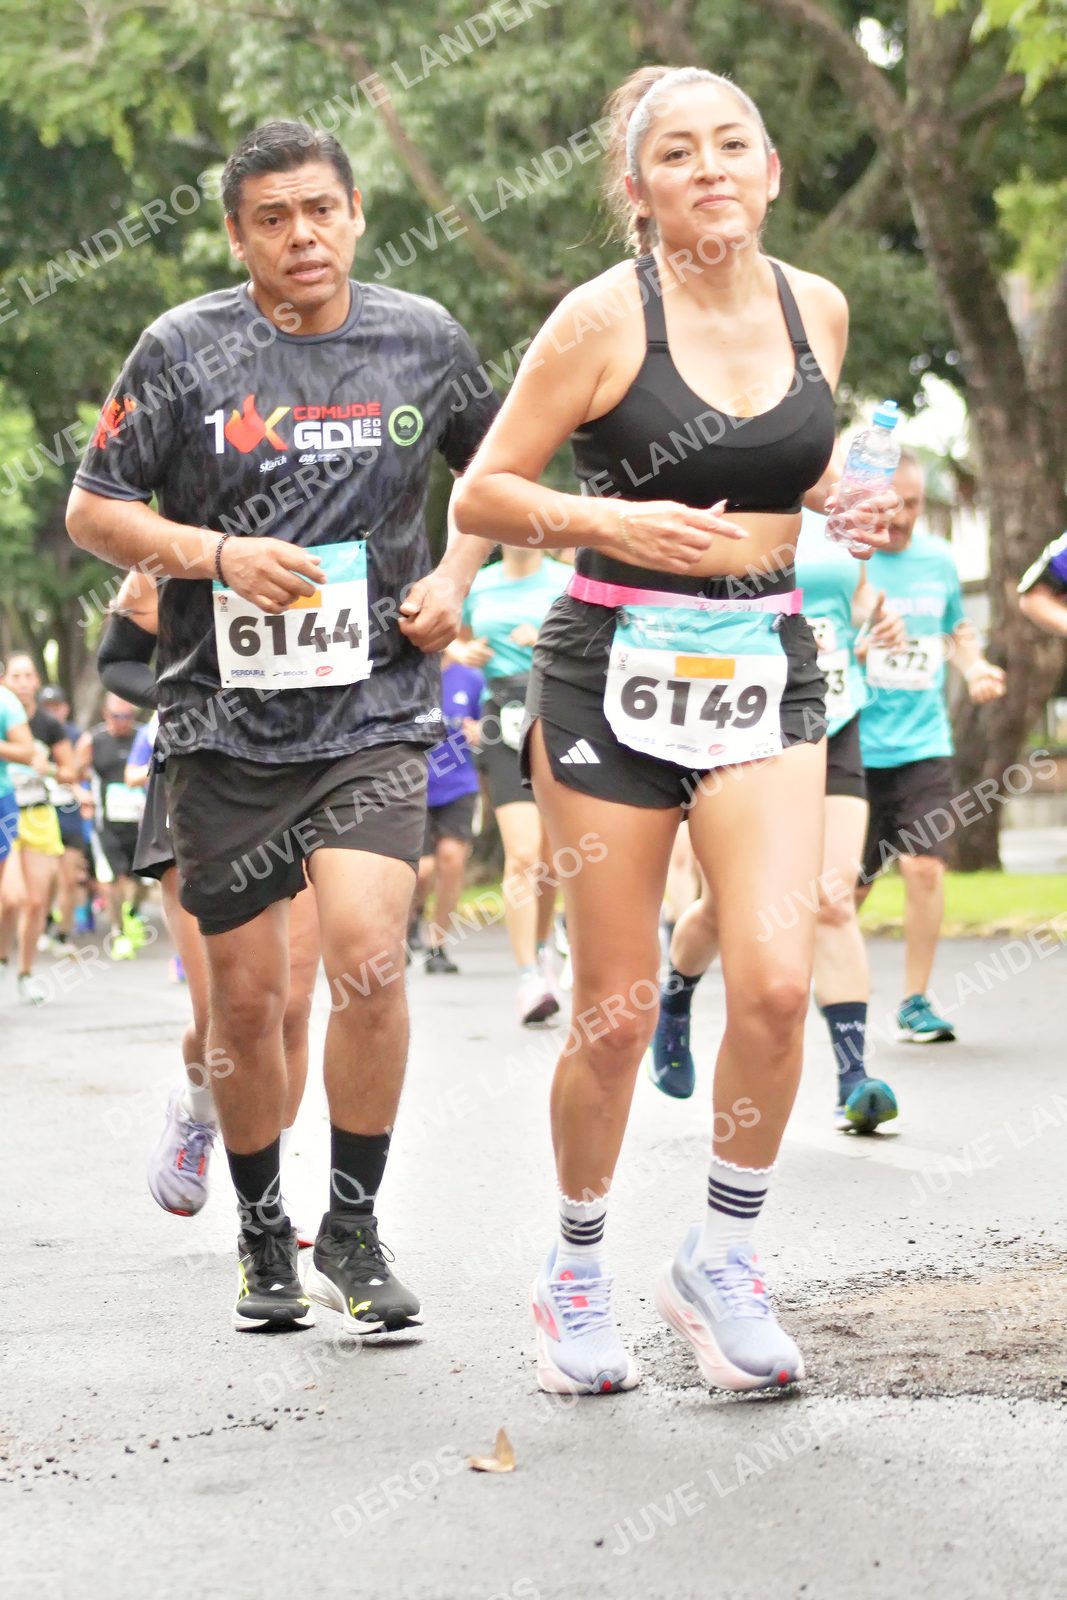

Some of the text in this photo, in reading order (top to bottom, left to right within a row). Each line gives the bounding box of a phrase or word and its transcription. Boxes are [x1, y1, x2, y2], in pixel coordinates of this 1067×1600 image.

[293, 402, 382, 421] COMUDE
[362, 418, 381, 427] 20
[294, 419, 381, 450] GDL
[362, 428, 381, 437] 26
[229, 608, 362, 656] 6144
[230, 669, 265, 677] PERDURA
[621, 676, 768, 729] 6149
